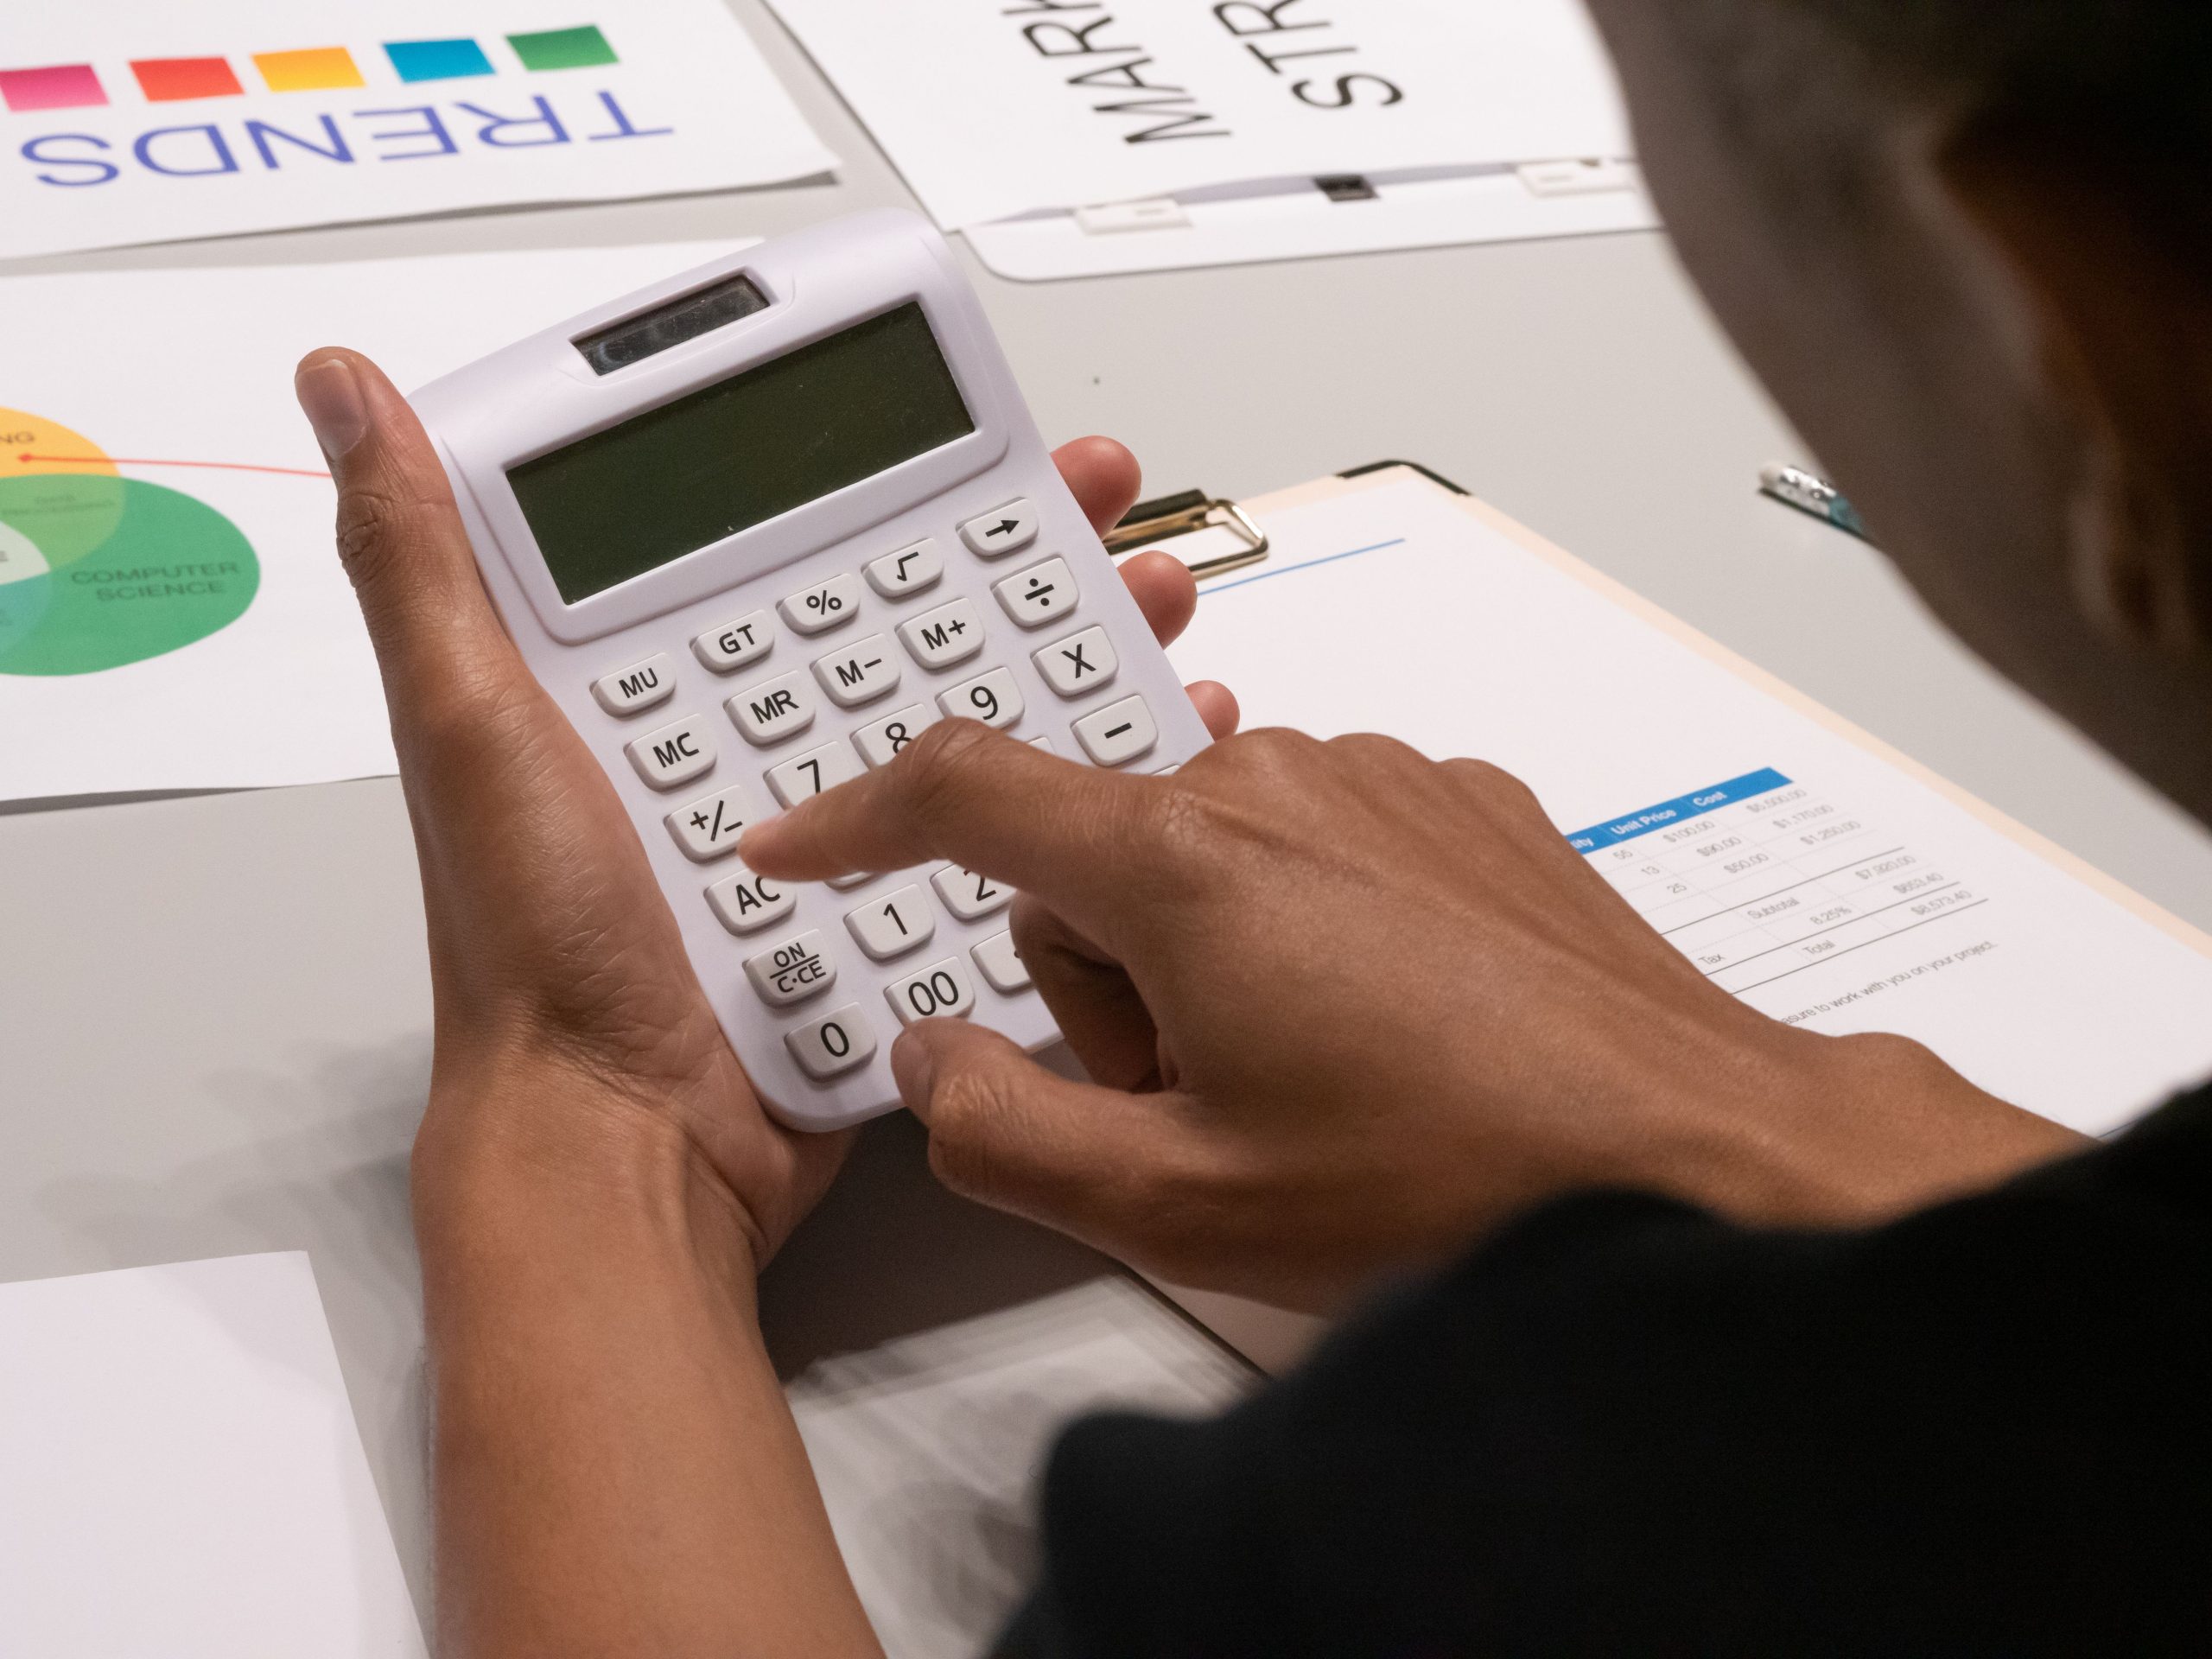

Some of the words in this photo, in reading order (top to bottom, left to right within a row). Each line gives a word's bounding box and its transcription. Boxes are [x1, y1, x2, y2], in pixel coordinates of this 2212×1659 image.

[19, 90, 675, 188] TRENDS
[70, 562, 240, 585] COMPUTER
[96, 580, 224, 601] SCIENCE
[806, 589, 842, 615] %
[719, 624, 756, 655] GT
[921, 618, 966, 651] M+
[620, 668, 659, 698] MU
[750, 690, 798, 724] MR
[970, 685, 999, 719] 9
[653, 732, 699, 768] MC
[886, 722, 913, 753] 8
[797, 760, 821, 795] 7
[1610, 819, 1643, 835] Unit
[1642, 809, 1677, 825] Price
[1693, 791, 1727, 808] Cost
[1662, 820, 1716, 843] $100.00
[735, 876, 780, 915] AC
[963, 869, 995, 900] 2
[1667, 882, 1688, 894] 25
[883, 903, 908, 936] 1
[1746, 897, 1800, 920] Subtotal
[772, 944, 805, 969] ON
[1697, 951, 1726, 967] Tax
[1802, 938, 1836, 957] Total
[908, 971, 959, 1015] 00
[1814, 1001, 1831, 1013] to
[1831, 990, 1860, 1008] work
[1859, 979, 1889, 997] with
[1889, 971, 1913, 987] you
[1910, 964, 1929, 976] on
[1927, 954, 1955, 971] your
[820, 1022, 849, 1058] 0
